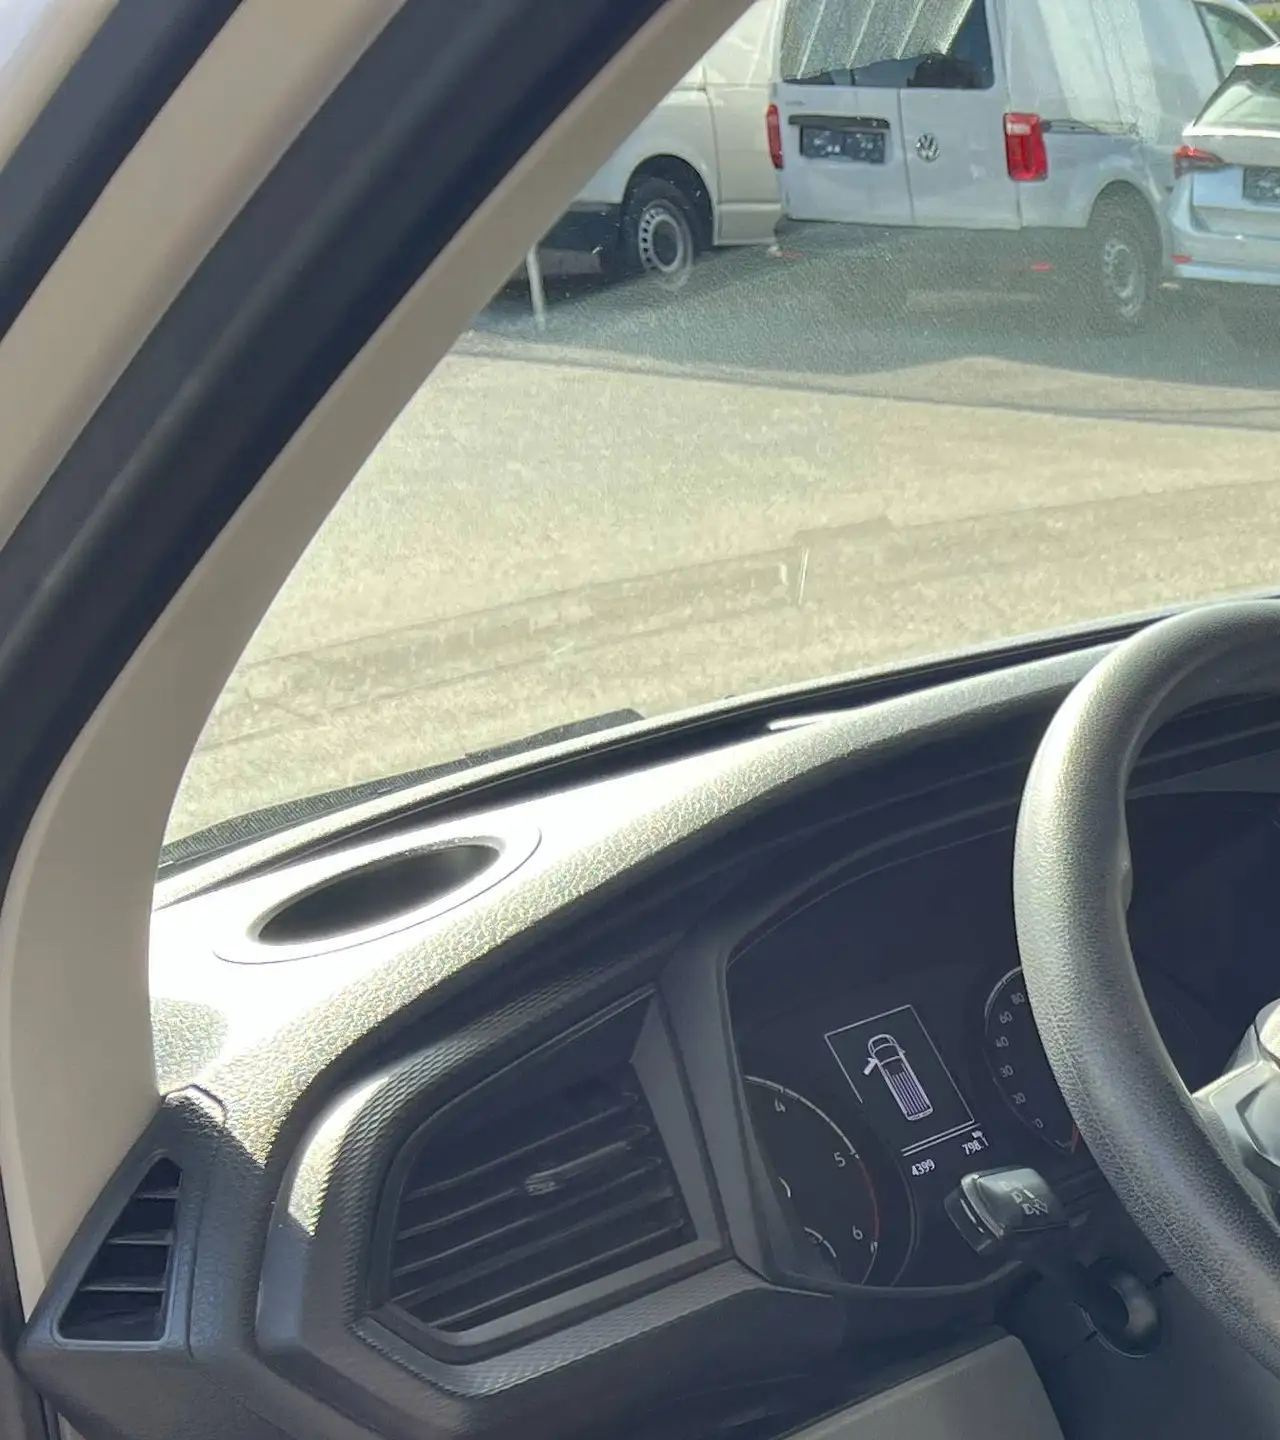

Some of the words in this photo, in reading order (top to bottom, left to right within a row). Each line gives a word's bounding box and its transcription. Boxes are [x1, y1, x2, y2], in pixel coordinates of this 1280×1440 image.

[1010, 991, 1026, 1006] 80
[999, 1010, 1013, 1025] 60
[995, 1035, 1010, 1049] 40
[999, 1064, 1014, 1078] 30
[774, 1098, 786, 1113] 4
[833, 1151, 847, 1168] 5
[911, 1158, 936, 1176] 4399
[852, 1225, 864, 1241] 6
